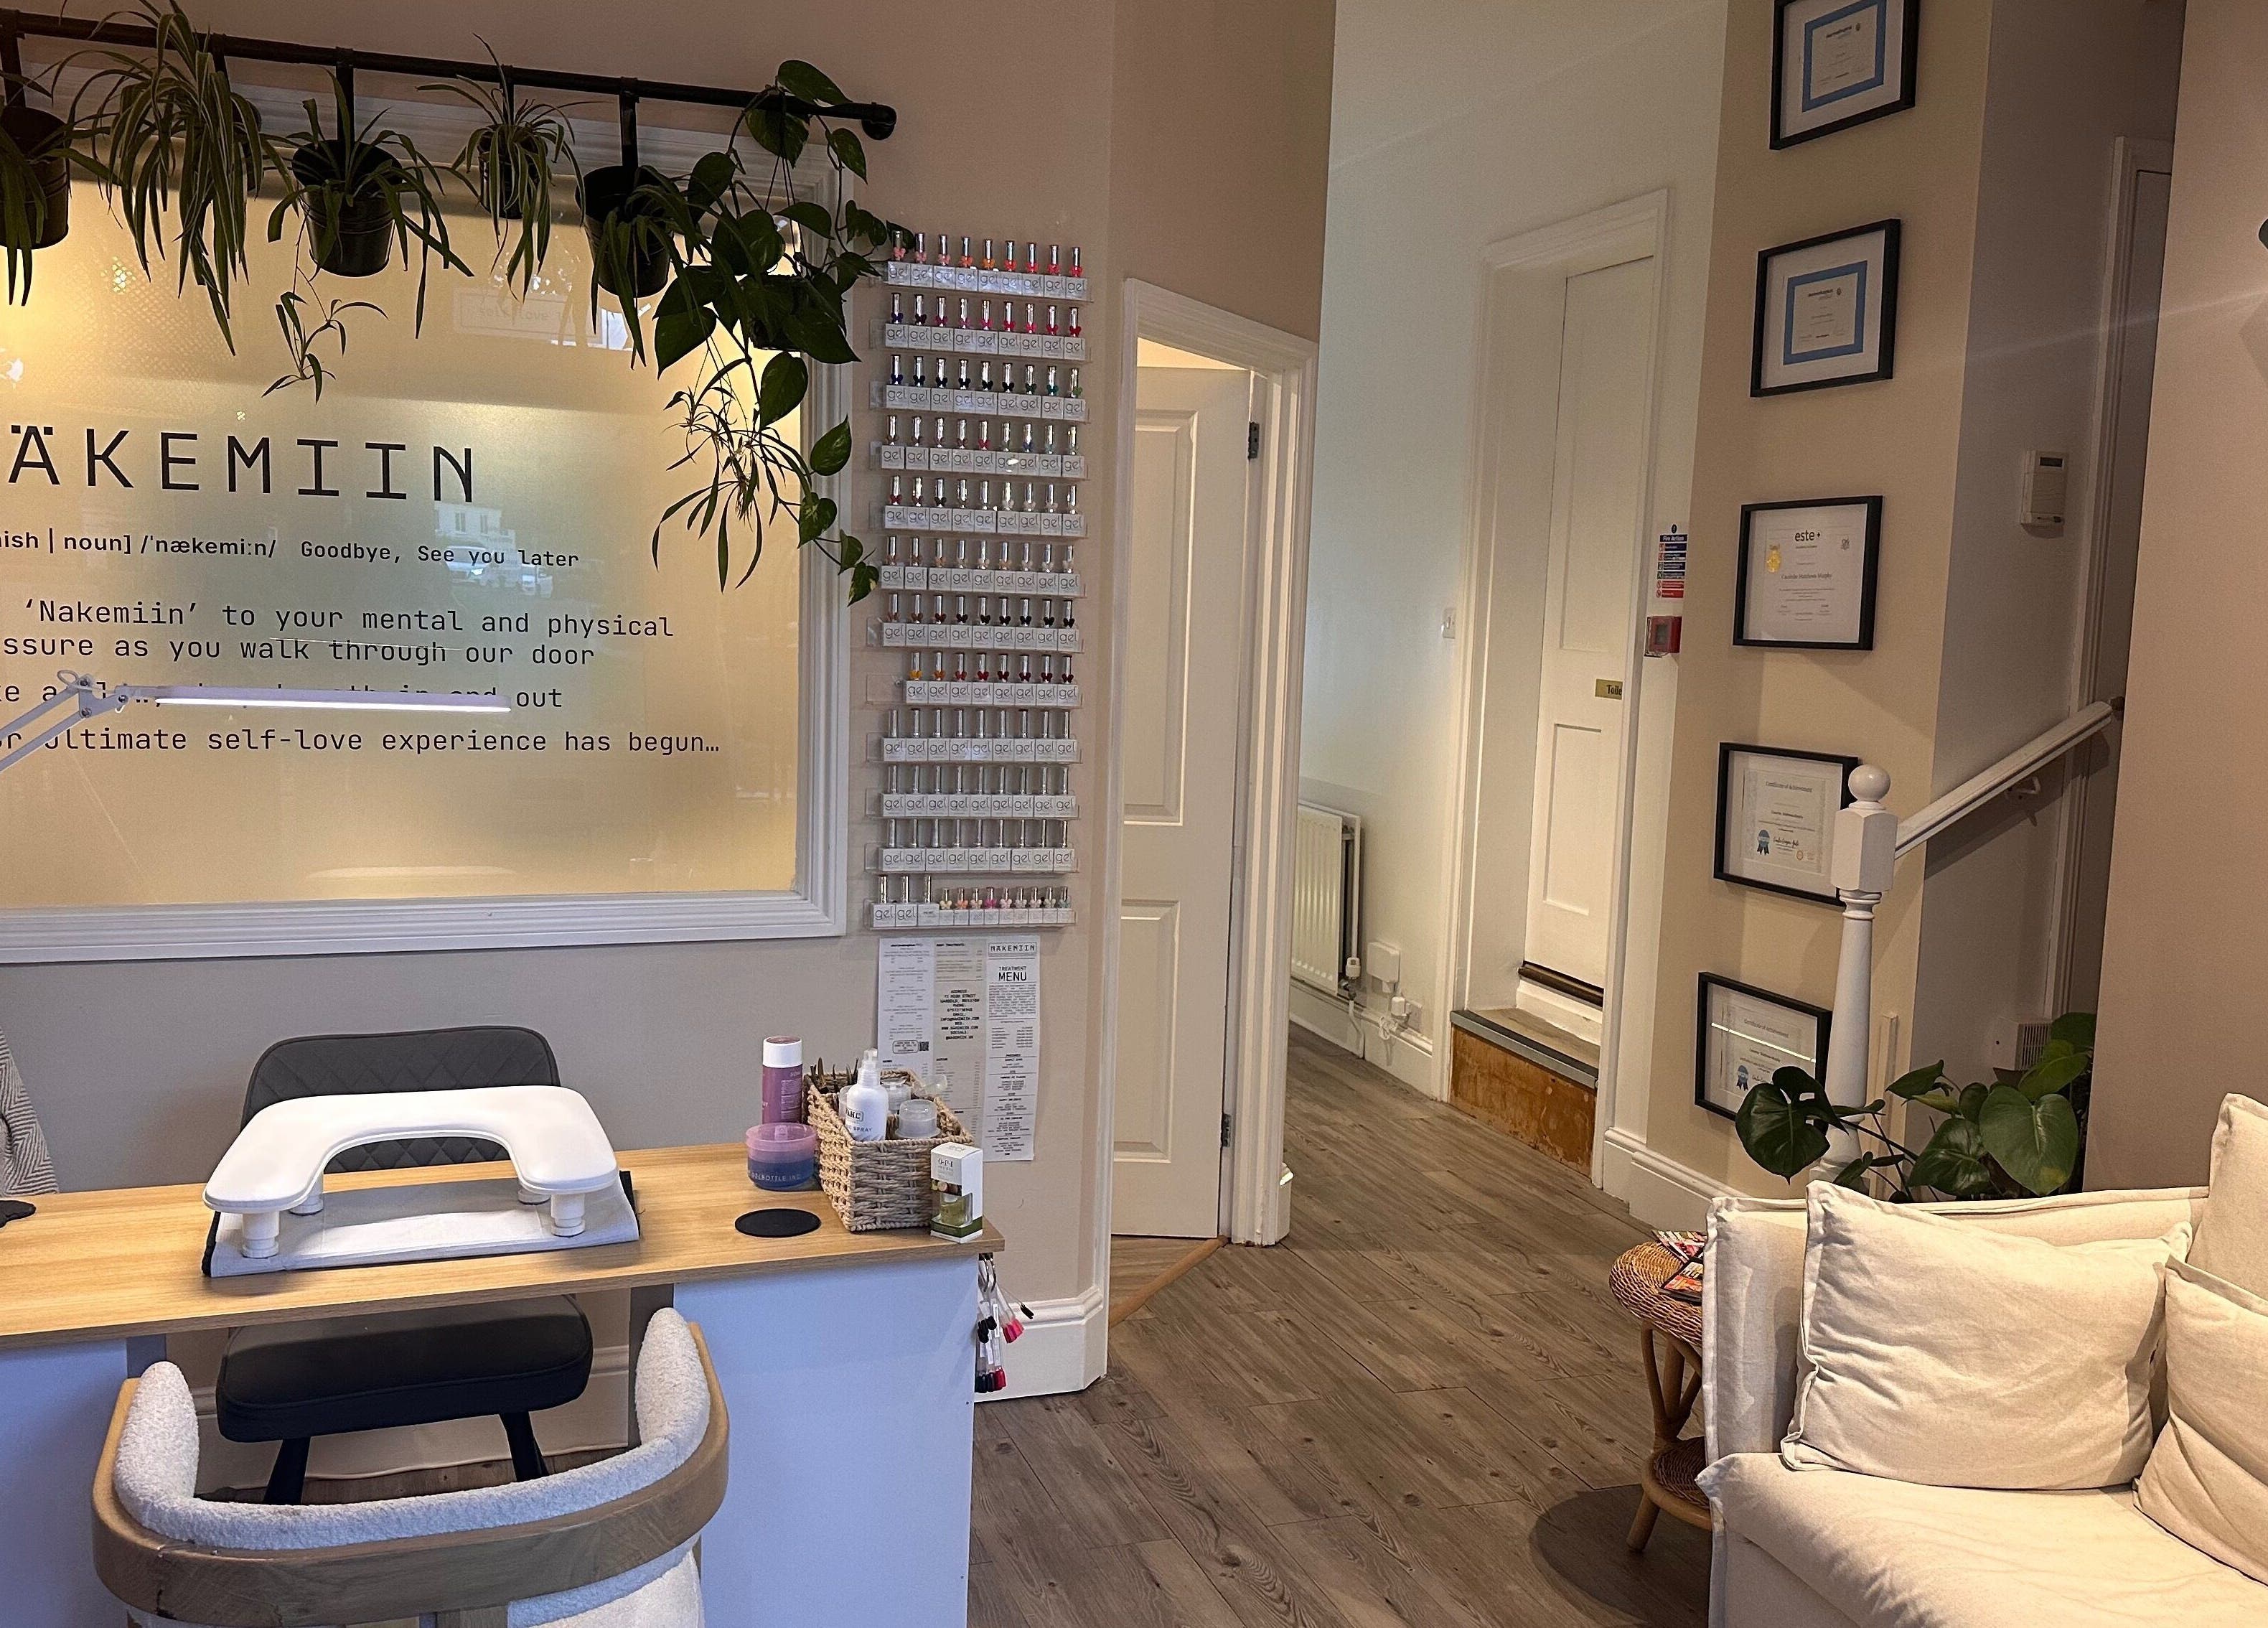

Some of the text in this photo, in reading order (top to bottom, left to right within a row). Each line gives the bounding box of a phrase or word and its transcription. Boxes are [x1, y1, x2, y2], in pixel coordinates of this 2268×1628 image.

[886, 325, 906, 341] gel
[910, 327, 929, 342] gel
[932, 328, 952, 344] gel
[955, 330, 974, 345] gel
[978, 332, 996, 347] gel
[1000, 333, 1018, 349] gel
[1021, 335, 1040, 350] gel
[1044, 336, 1062, 352] gel
[1065, 337, 1084, 353] gel
[887, 387, 906, 402] gel
[910, 388, 929, 403] gel
[932, 390, 951, 405] gel
[955, 391, 973, 406] gel
[976, 393, 995, 408] gel
[999, 395, 1017, 409] gel
[1021, 396, 1039, 411] gel
[1044, 398, 1062, 413] gel
[1065, 399, 1084, 414] gel
[883, 446, 903, 462] gel
[907, 448, 927, 464] gel
[932, 449, 951, 464] gel
[952, 450, 971, 466] gel
[975, 452, 993, 467] gel
[1018, 454, 1037, 469] gel
[1041, 454, 1059, 470] gel
[1064, 456, 1082, 471] gel
[886, 507, 906, 522] gel
[908, 507, 928, 523] gel
[931, 509, 951, 524] gel
[953, 510, 973, 525] gel
[975, 511, 995, 525] gel
[998, 512, 1017, 527] gel
[1021, 513, 1039, 528] gel
[1042, 514, 1062, 528] gel
[1064, 515, 1082, 530] gel
[64, 535, 131, 555] noun]
[301, 541, 400, 563] Goodbye,
[418, 545, 454, 562] See
[468, 551, 505, 564] you
[517, 549, 579, 567] later
[883, 567, 903, 583] gel
[906, 568, 926, 584] gel
[929, 569, 950, 585] gel
[952, 570, 970, 586] gel
[975, 571, 993, 586] gel
[996, 571, 1014, 587] gel
[1017, 572, 1036, 588] gel
[1039, 573, 1057, 589] gel
[1060, 574, 1079, 589] gel
[222, 605, 255, 626] to
[275, 610, 343, 632] your
[362, 610, 463, 631] mental
[482, 612, 528, 632] and
[548, 614, 673, 639] physical
[884, 624, 904, 640] gel
[907, 625, 927, 640] gel
[929, 626, 949, 641] gel
[952, 627, 970, 641] gel
[974, 627, 992, 642] gel
[995, 628, 1013, 642] gel
[1016, 629, 1034, 643] gel
[1037, 630, 1056, 644] gel
[1059, 630, 1077, 645] gel
[115, 640, 148, 657] as
[169, 641, 220, 662] you
[240, 639, 309, 660] walk
[328, 640, 446, 666] through
[466, 647, 513, 663] our
[533, 644, 594, 665] door
[0, 685, 20, 702] e
[515, 688, 563, 708] out
[907, 683, 927, 698] gel
[929, 683, 949, 698] gel
[951, 683, 970, 698] gel
[973, 683, 992, 699] gel
[995, 684, 1013, 699] gel
[1016, 684, 1034, 699] gel
[1038, 684, 1056, 700] gel
[1059, 685, 1077, 700] gel
[1606, 684, 1622, 696] Toile
[0, 731, 22, 749] r
[44, 727, 187, 750] ultimate
[208, 729, 362, 750] self-love
[383, 729, 546, 754] experience
[566, 731, 610, 751] has
[885, 739, 905, 755] gel
[907, 739, 927, 755] gel
[929, 739, 948, 755] gel
[951, 739, 970, 755] gel
[973, 740, 991, 755] gel
[994, 740, 1013, 755] gel
[1016, 740, 1034, 755] gel
[1036, 740, 1055, 755] gel
[1057, 740, 1075, 755] gel
[884, 796, 904, 811] gel
[906, 796, 925, 811] gel
[928, 796, 947, 811] gel
[950, 796, 968, 811] gel
[971, 796, 990, 811] gel
[993, 796, 1011, 811] gel
[1014, 796, 1033, 811] gel
[1035, 796, 1053, 811] gel
[1056, 796, 1074, 811] gel
[884, 851, 903, 866] gel
[905, 851, 924, 866] gel
[927, 851, 946, 866] gel
[948, 851, 967, 866] gel
[970, 850, 989, 865] gel
[991, 850, 1011, 865] gel
[1013, 850, 1031, 865] gel
[1034, 850, 1053, 865] gel
[1055, 850, 1074, 864] gel
[875, 905, 895, 921] gel
[896, 905, 917, 921] gel
[998, 971, 1027, 982] MENU
